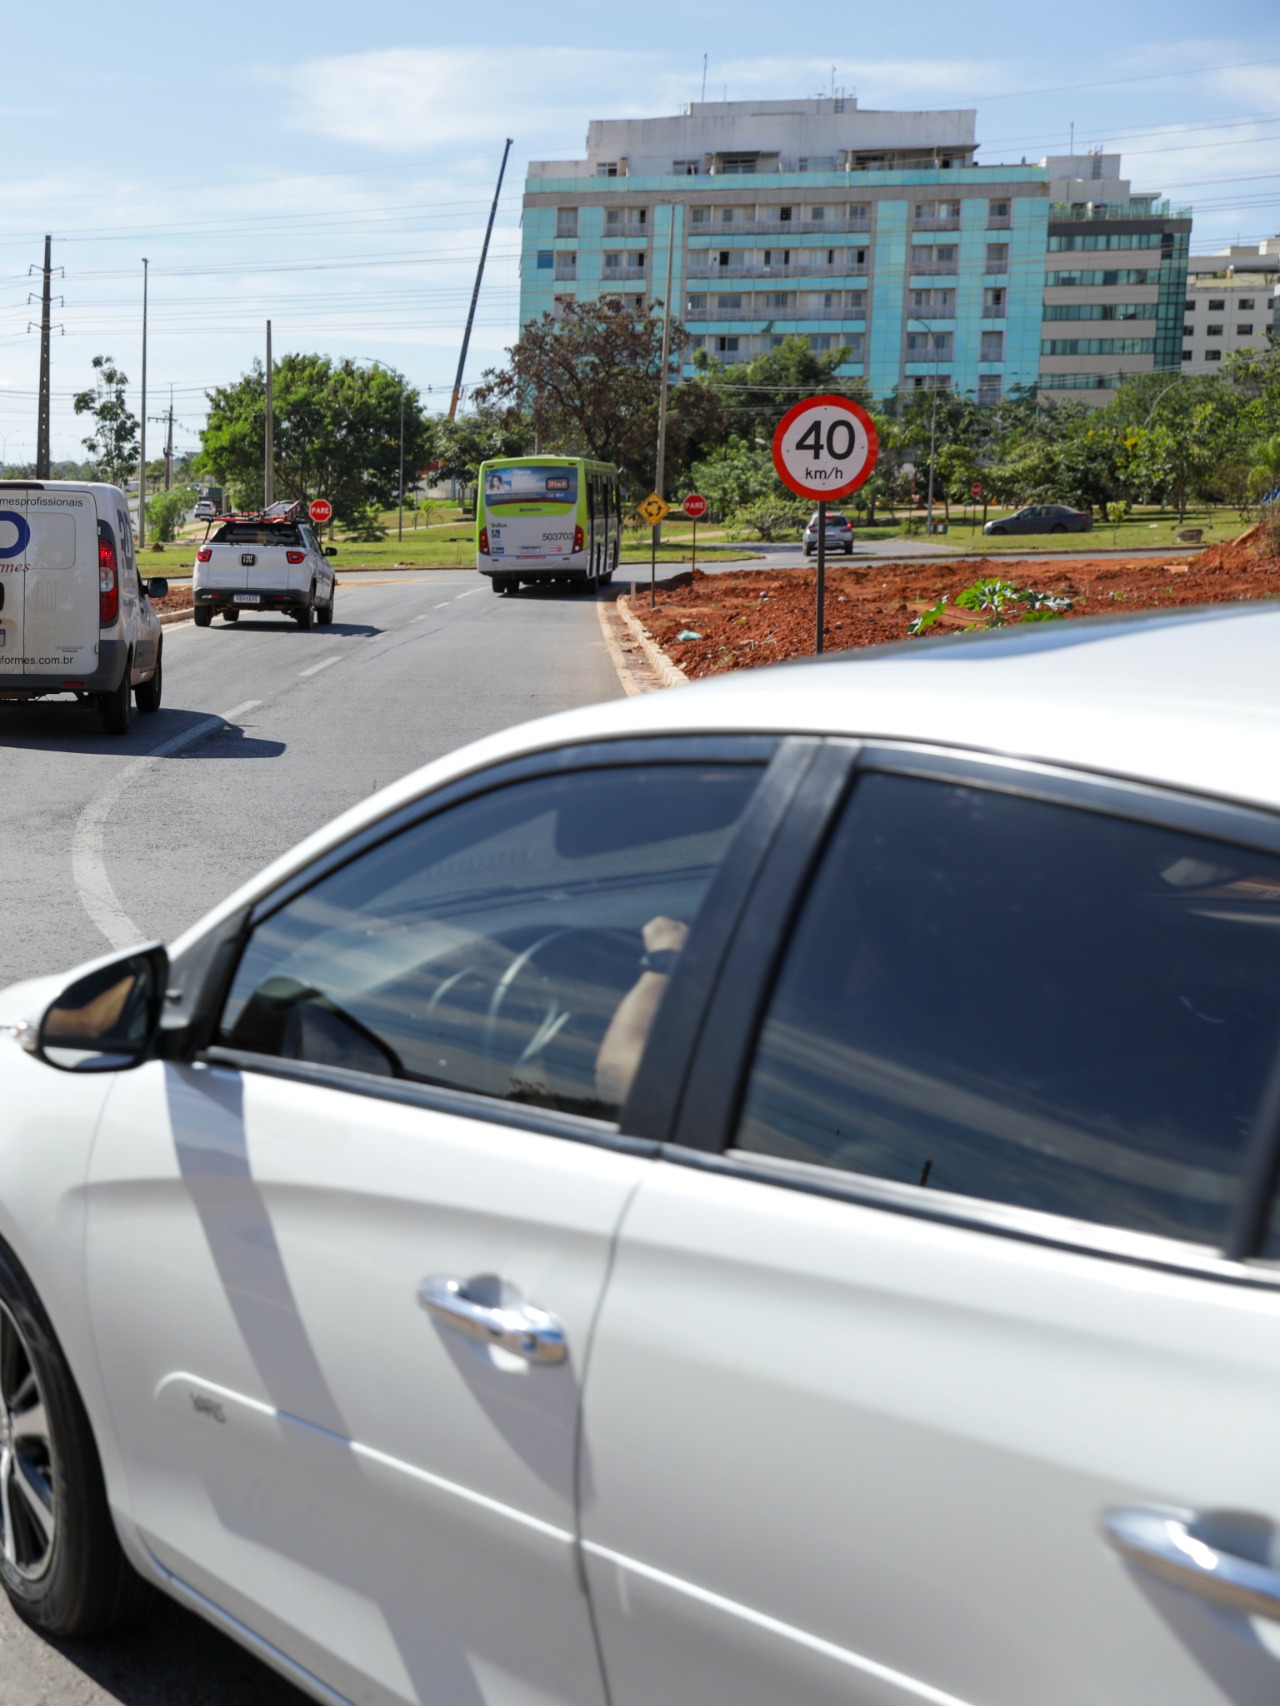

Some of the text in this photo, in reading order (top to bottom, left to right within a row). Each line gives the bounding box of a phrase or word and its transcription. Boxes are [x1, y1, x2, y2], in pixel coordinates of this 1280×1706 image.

[795, 419, 856, 460] 40
[805, 466, 843, 480] km/h
[685, 502, 704, 510] PARE
[542, 532, 574, 541] 503703
